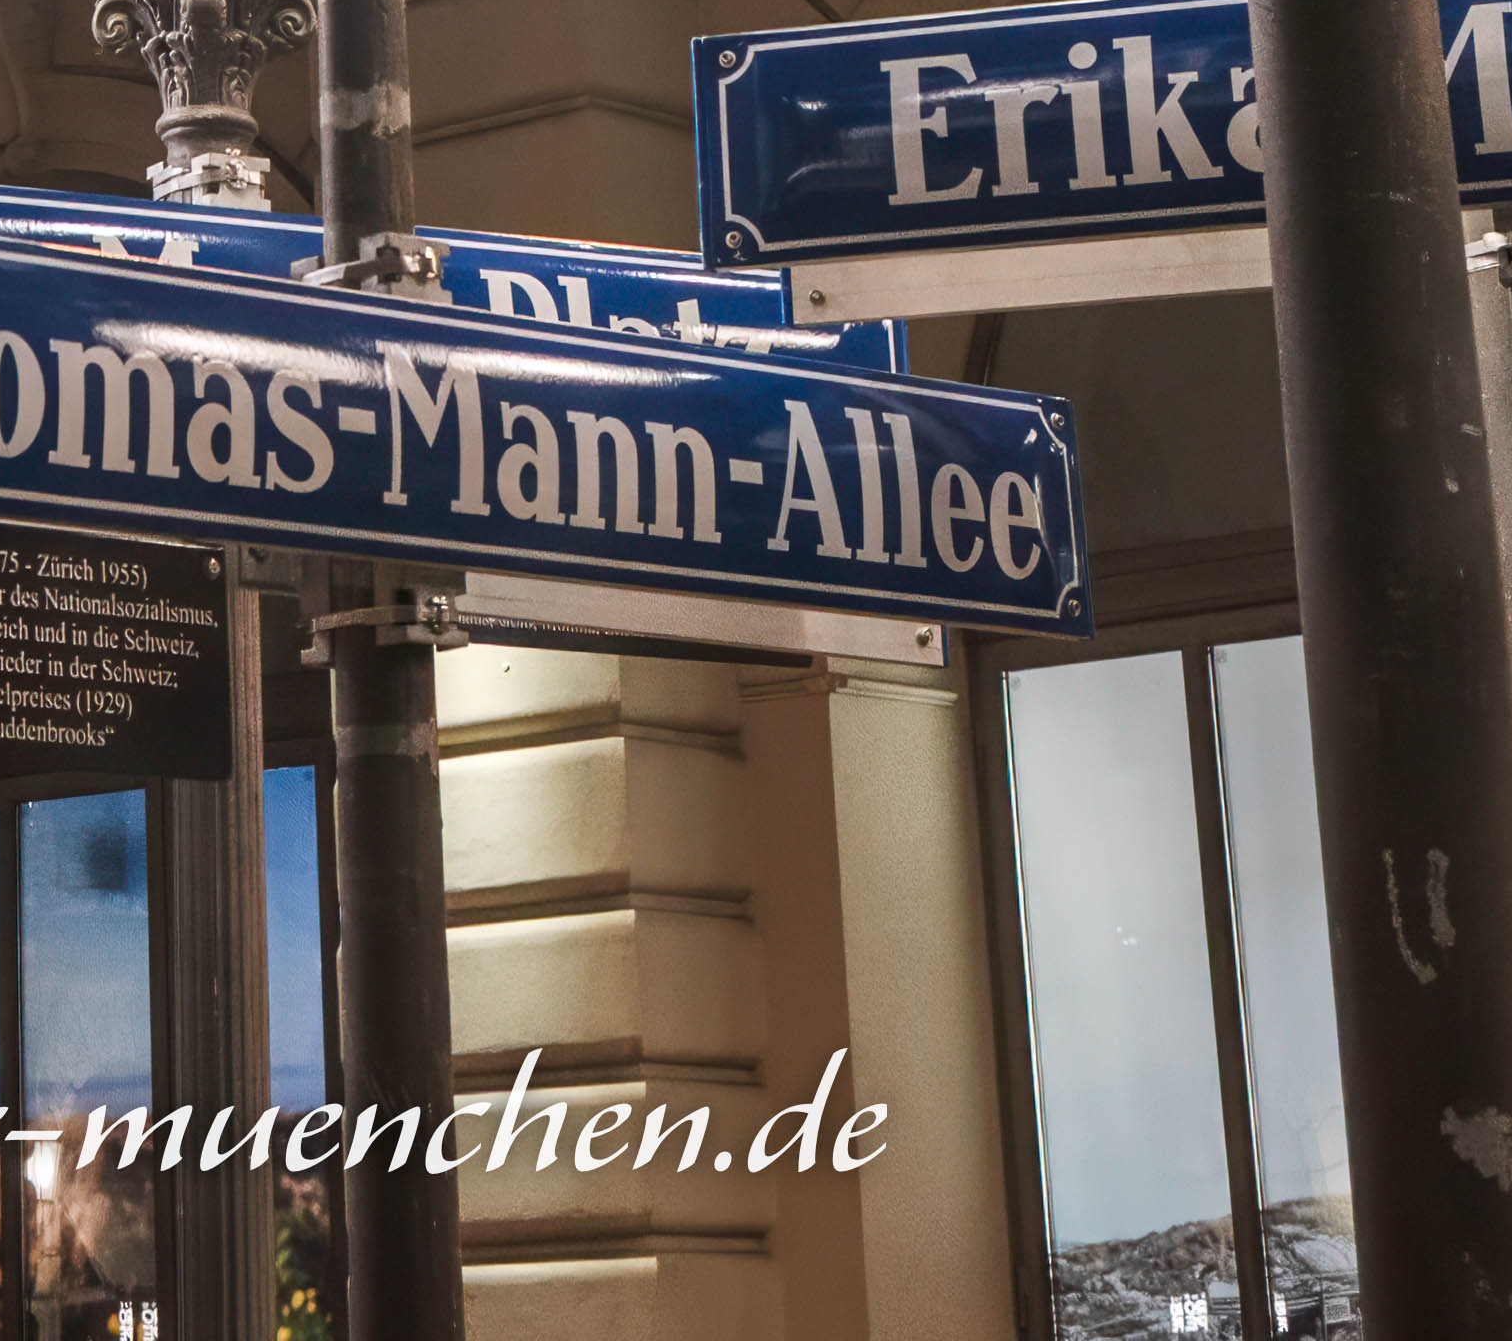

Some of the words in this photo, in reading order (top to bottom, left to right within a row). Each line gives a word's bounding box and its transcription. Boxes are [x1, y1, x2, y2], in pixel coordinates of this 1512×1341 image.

[36, 553, 94, 582] Zürich
[100, 559, 148, 592] 1955)
[9, 583, 40, 610] des
[34, 620, 67, 645] und
[71, 622, 89, 648] in
[92, 624, 120, 650] die
[47, 652, 65, 678] in
[68, 654, 99, 681] der
[75, 688, 133, 722] (1929)
